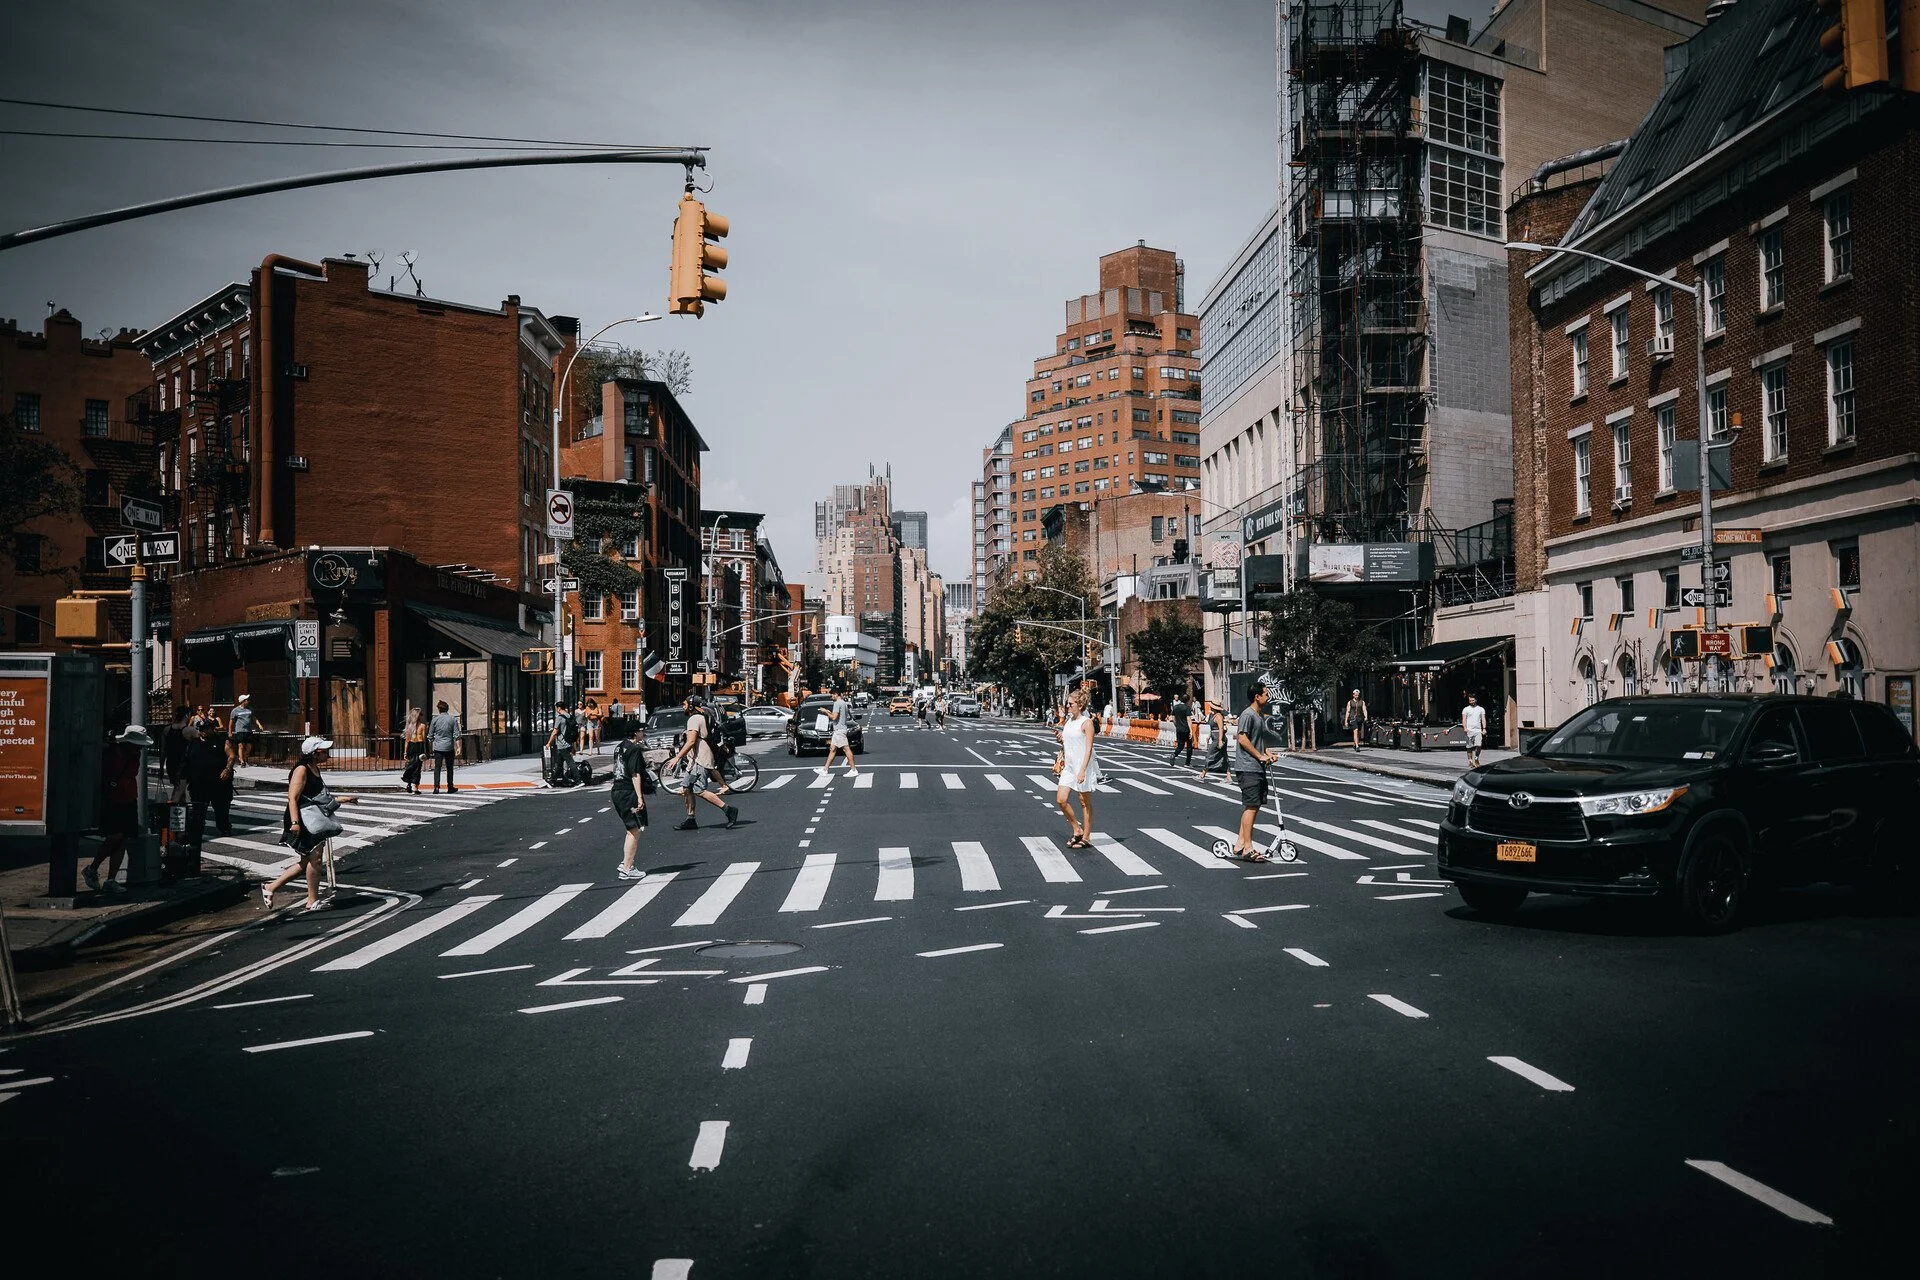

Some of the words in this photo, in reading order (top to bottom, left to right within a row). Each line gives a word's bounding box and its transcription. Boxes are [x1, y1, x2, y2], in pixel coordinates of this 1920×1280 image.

[127, 507, 139, 520] ONE
[145, 511, 158, 523] WAY
[1256, 517, 1264, 531] NEW
[1265, 512, 1274, 528] YORK
[1716, 533, 1750, 543] STONEWALL
[1751, 533, 1758, 542] PL
[116, 543, 136, 557] ONE
[146, 541, 170, 555] WAY
[1688, 593, 1702, 602] ONE
[299, 635, 316, 646] 20
[19, 718, 36, 726] the
[4, 727, 15, 735] of
[0, 737, 35, 746] pected
